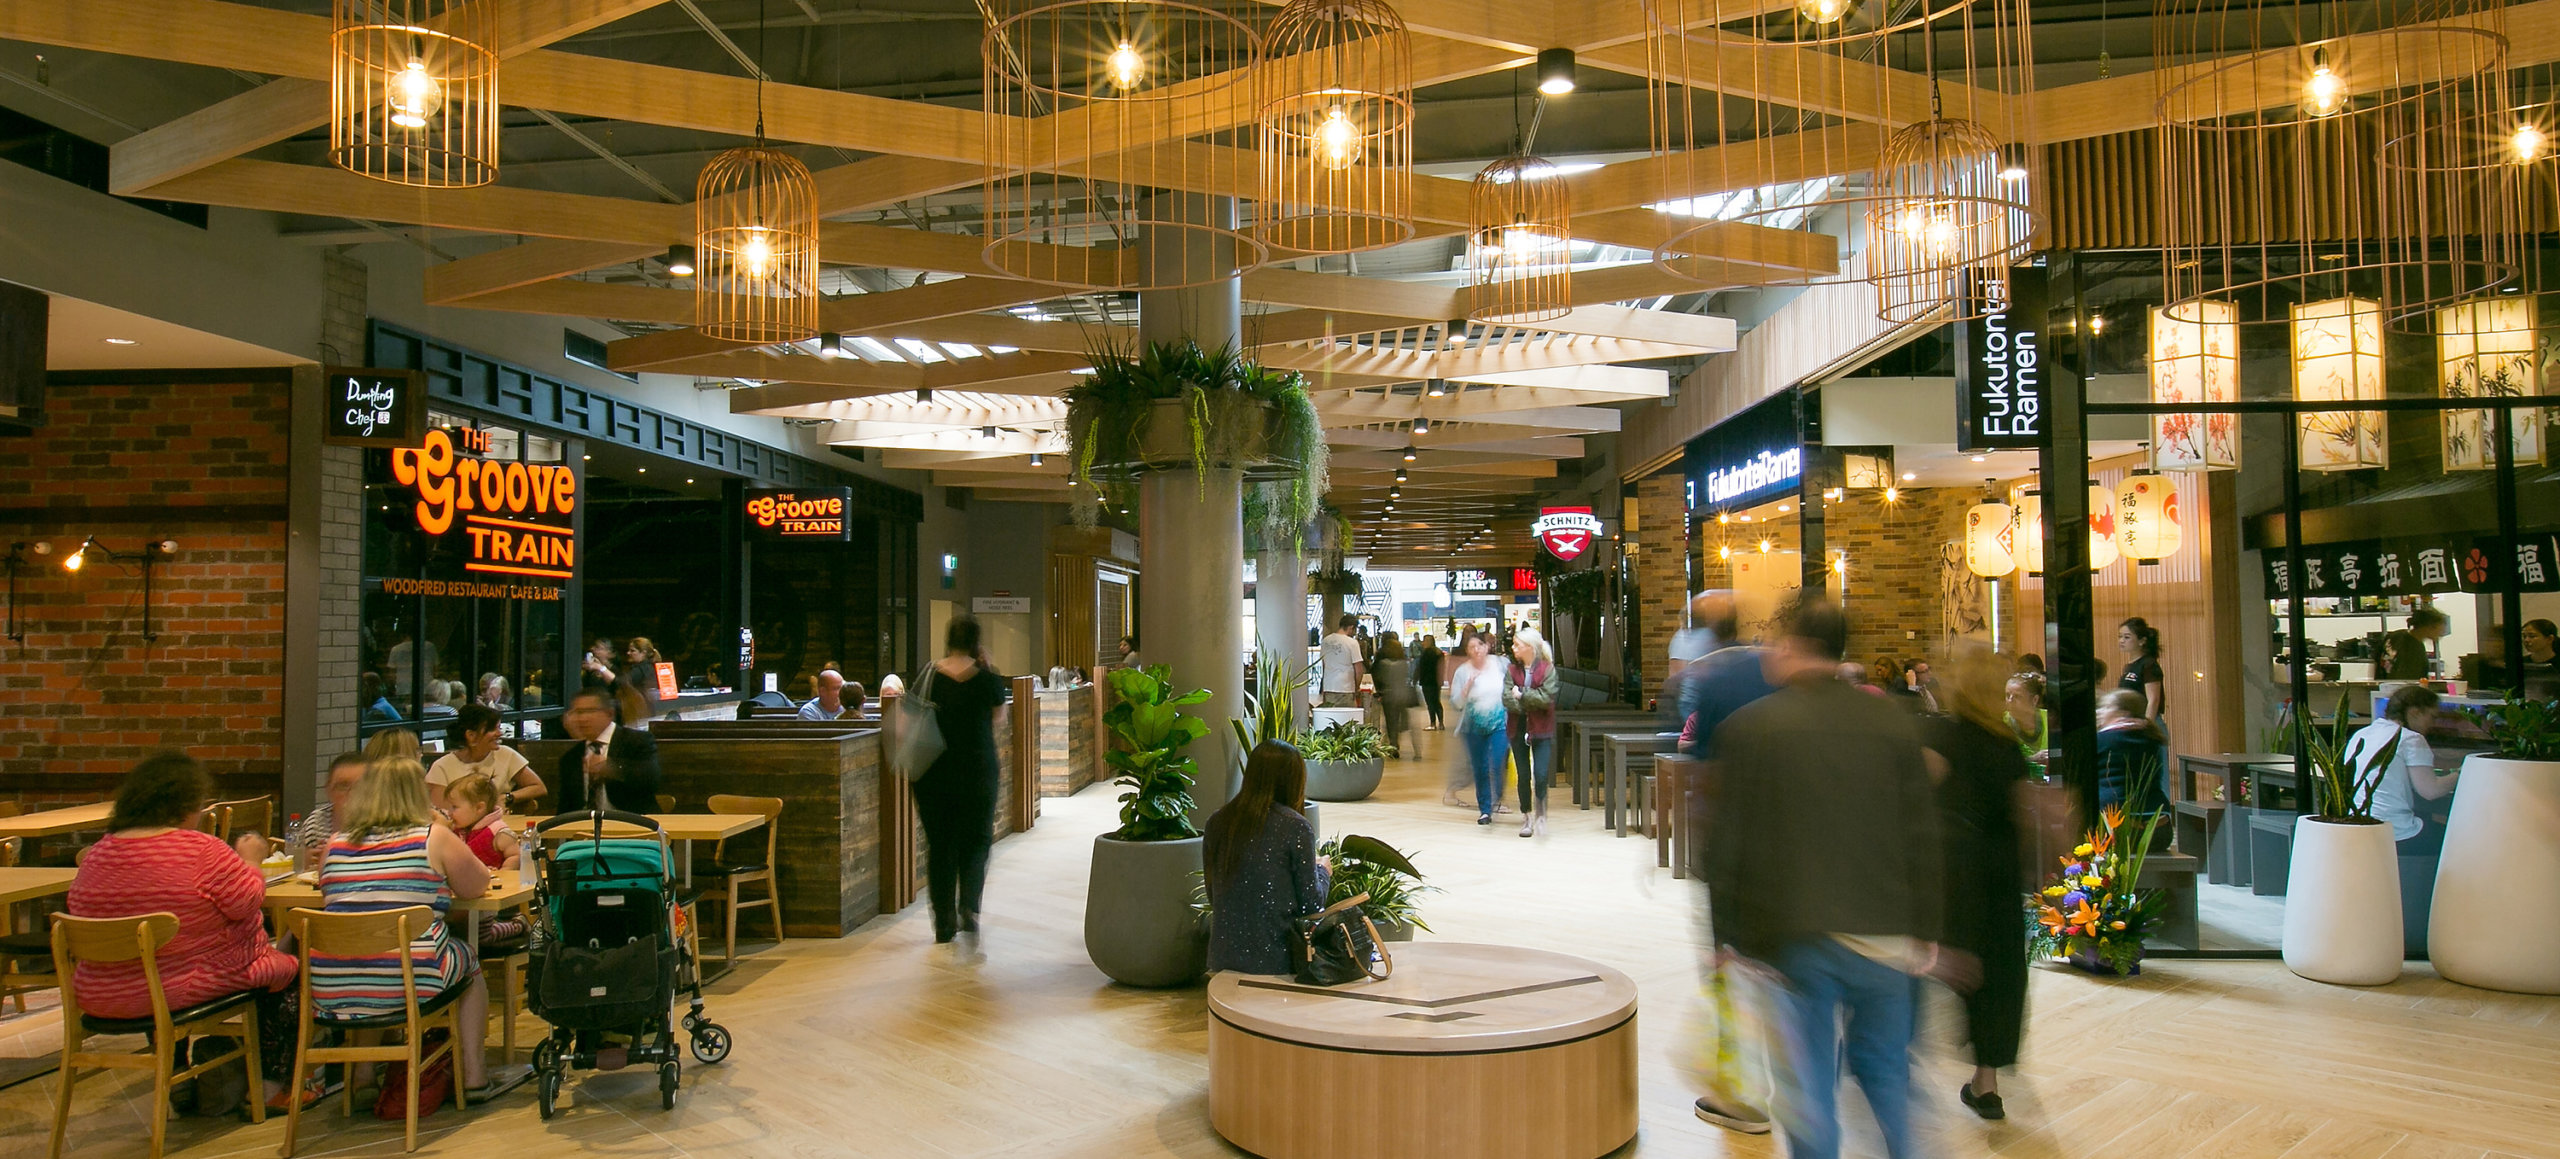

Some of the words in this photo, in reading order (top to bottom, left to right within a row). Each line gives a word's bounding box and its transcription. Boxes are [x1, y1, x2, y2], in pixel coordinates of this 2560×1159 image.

[1981, 279, 2010, 436] Fukutontei
[347, 377, 394, 410] Dumpling
[2012, 330, 2039, 436] Ramen
[345, 408, 376, 437] Chef
[461, 427, 493, 453] THE
[393, 430, 575, 535] Groove
[777, 493, 795, 501] THE
[747, 496, 842, 526] Groove
[1543, 516, 1591, 527] SCHNITZ
[781, 521, 842, 532] TRAIN
[466, 527, 574, 566] TRAIN
[383, 579, 446, 595] WOODFIRED
[448, 582, 507, 598] RESTAURANT
[534, 588, 541, 600] &
[542, 587, 559, 600] BAR
